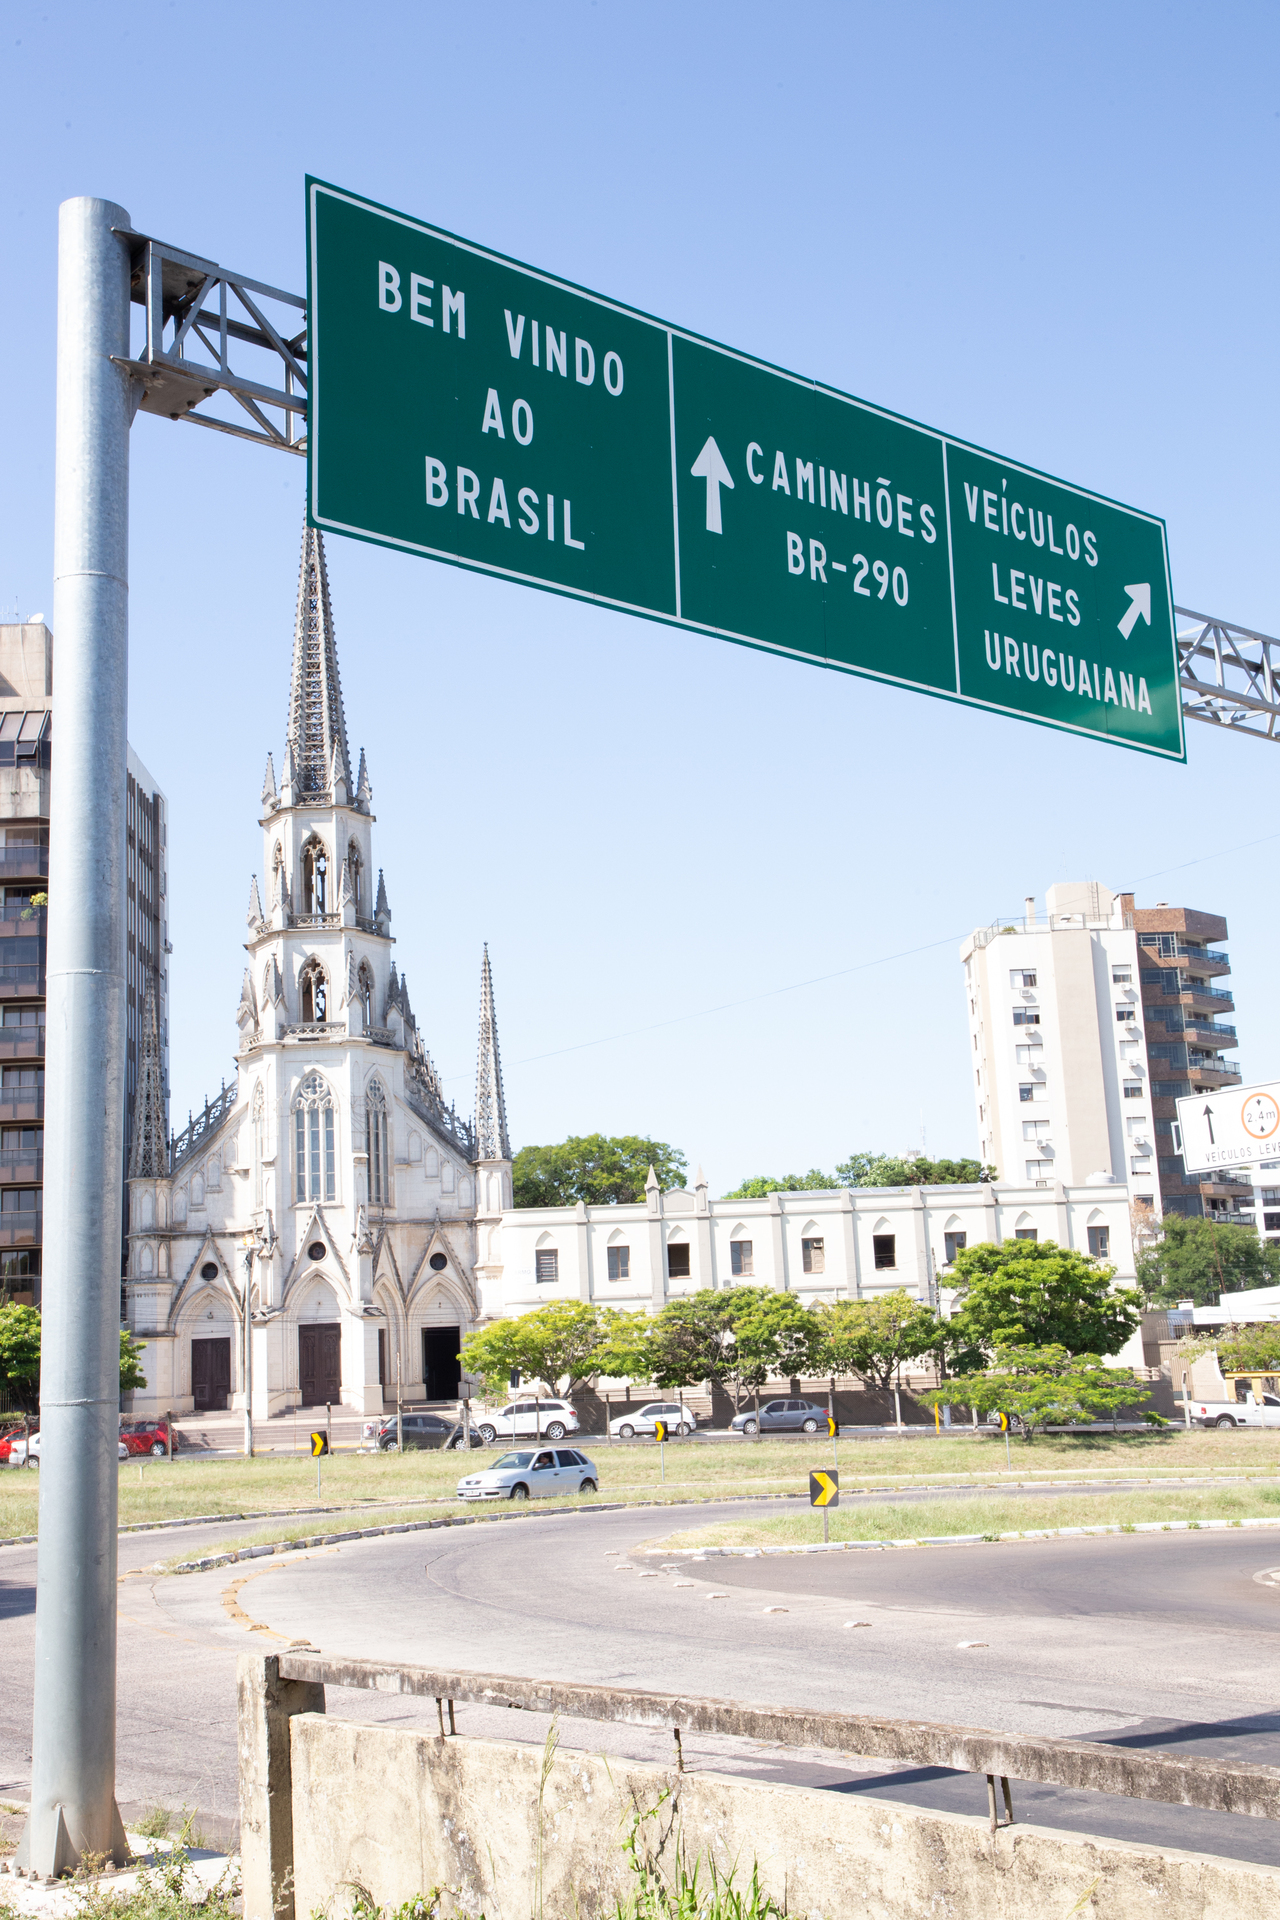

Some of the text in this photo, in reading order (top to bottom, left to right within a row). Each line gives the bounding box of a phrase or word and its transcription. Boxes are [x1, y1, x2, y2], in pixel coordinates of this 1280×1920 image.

[378, 260, 625, 396] BEM VINDO
[481, 387, 534, 446] AO
[425, 455, 585, 551] BRASIL
[746, 441, 937, 544] CAMINHÕES
[963, 478, 1099, 567] VEÍCULOS
[786, 530, 909, 607] BR-290
[991, 562, 1081, 627] LEVES
[984, 629, 1153, 716] URUGUAIANA
[1205, 1146, 1252, 1163] VEÍCULOS
